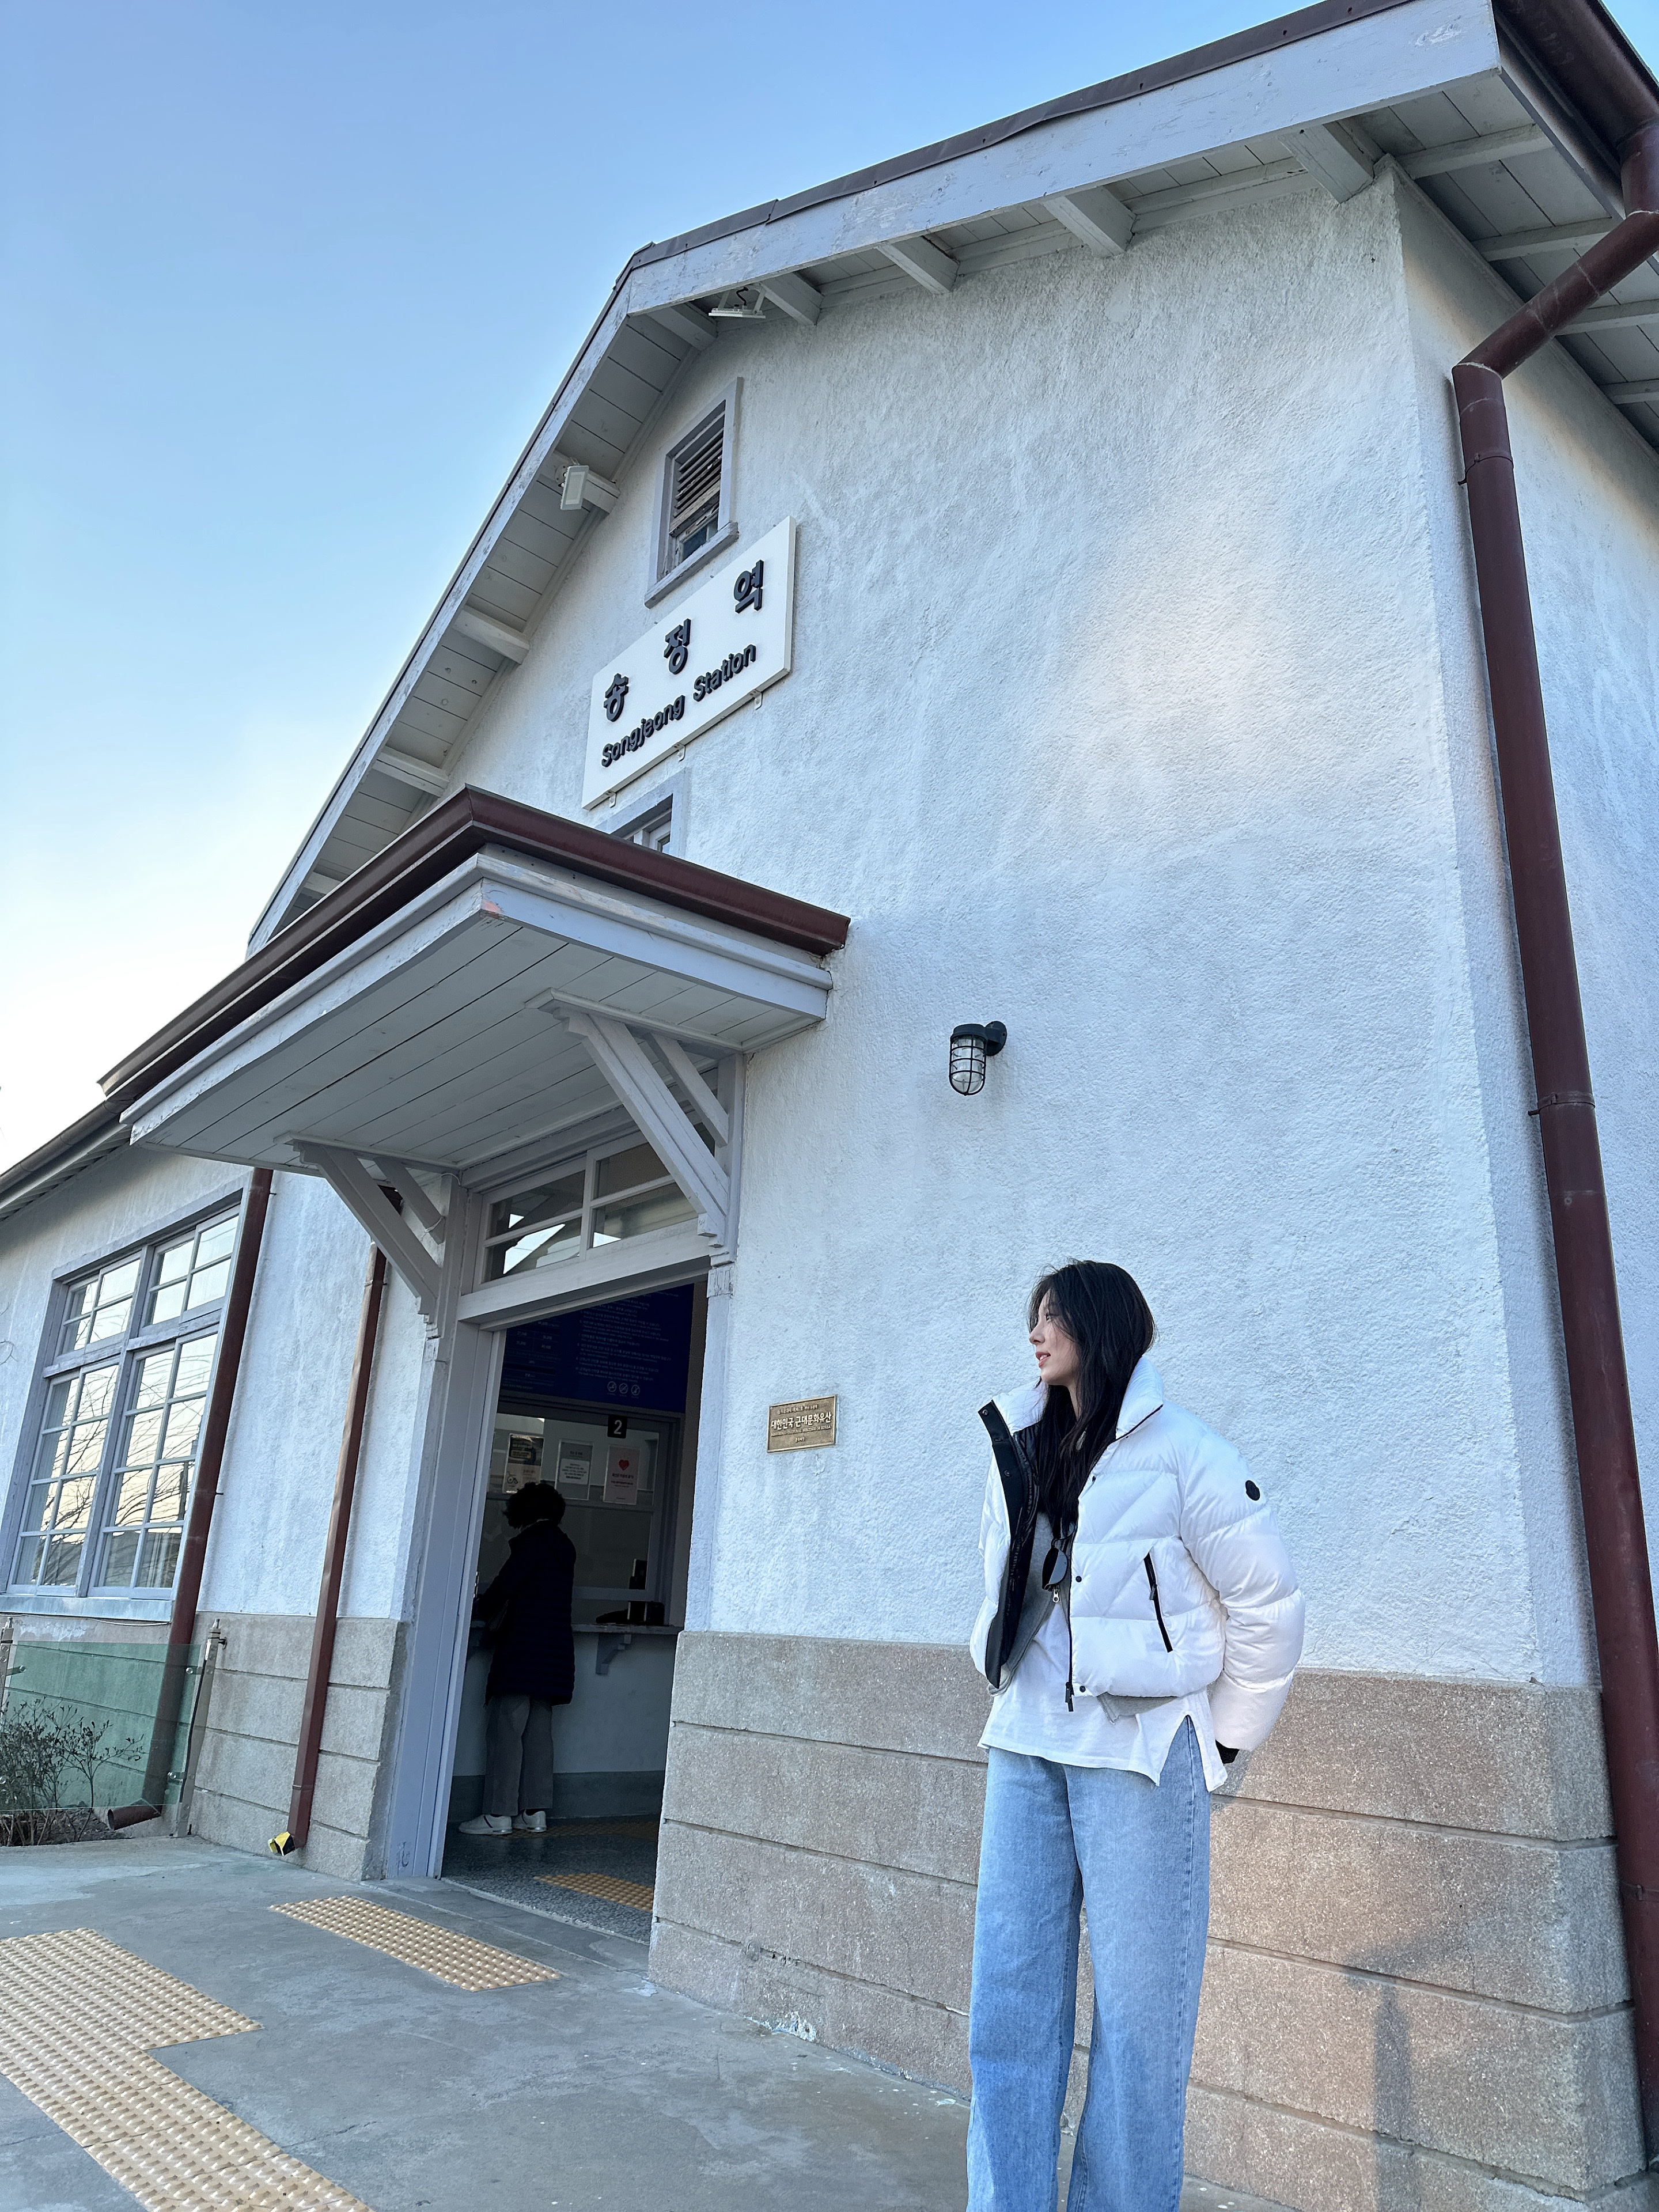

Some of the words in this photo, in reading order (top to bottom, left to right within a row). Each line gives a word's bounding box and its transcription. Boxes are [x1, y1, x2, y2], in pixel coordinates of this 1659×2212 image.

[604, 673, 629, 722] 송
[664, 618, 691, 675] 정
[733, 559, 764, 613] 역
[601, 695, 685, 767] Songjeong
[693, 644, 756, 702] Station
[614, 1419, 622, 1434] 2
[771, 1417, 794, 1430] 대한민국
[795, 1411, 832, 1427] 근대문화유산
